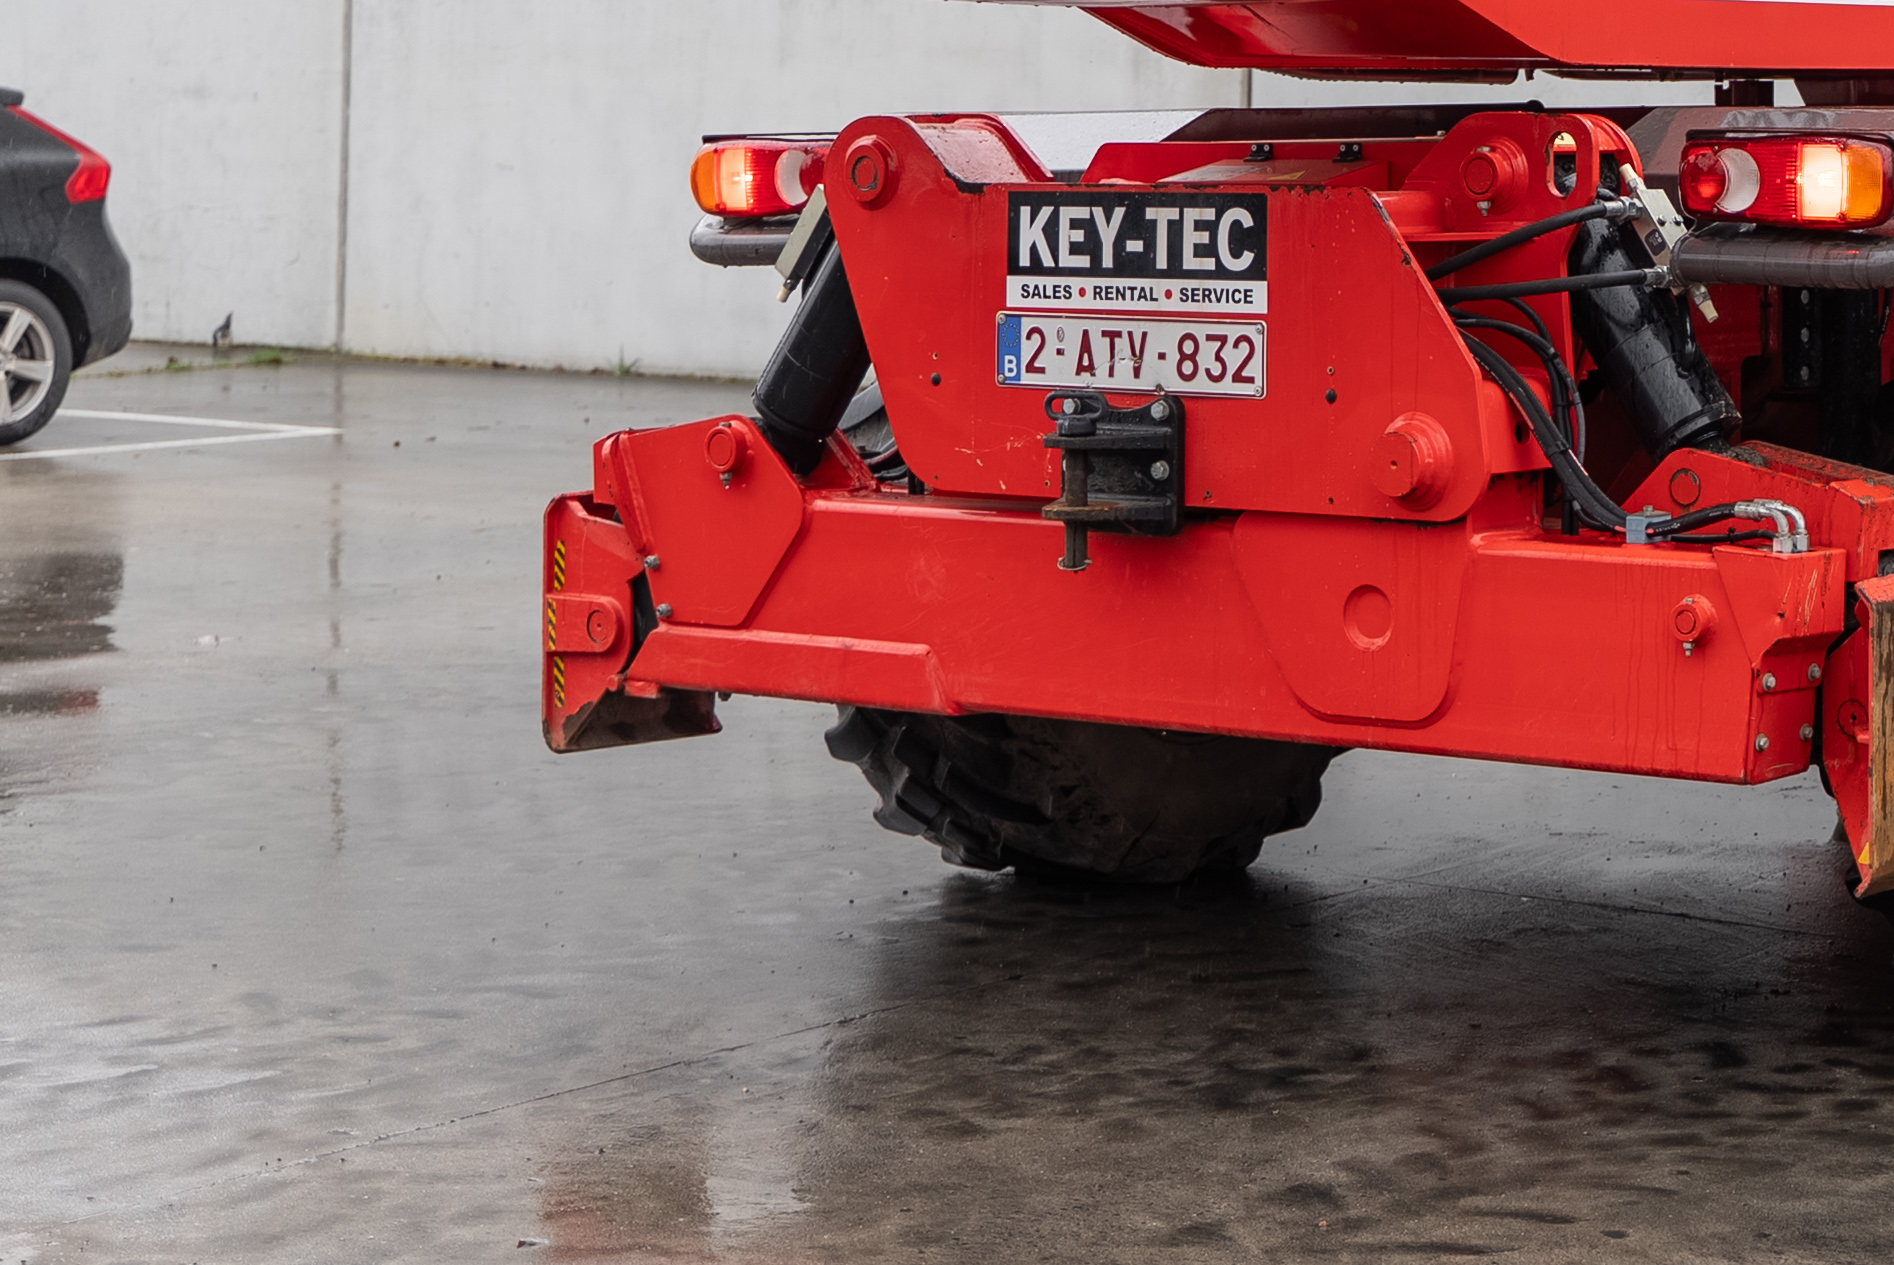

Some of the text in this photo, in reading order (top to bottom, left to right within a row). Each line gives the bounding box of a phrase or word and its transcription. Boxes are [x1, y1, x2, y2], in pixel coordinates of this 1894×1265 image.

[1018, 205, 1255, 272] KEY-TEC
[1020, 283, 1254, 305] SALES RENTAL SERVICE
[1004, 355, 1017, 377] B
